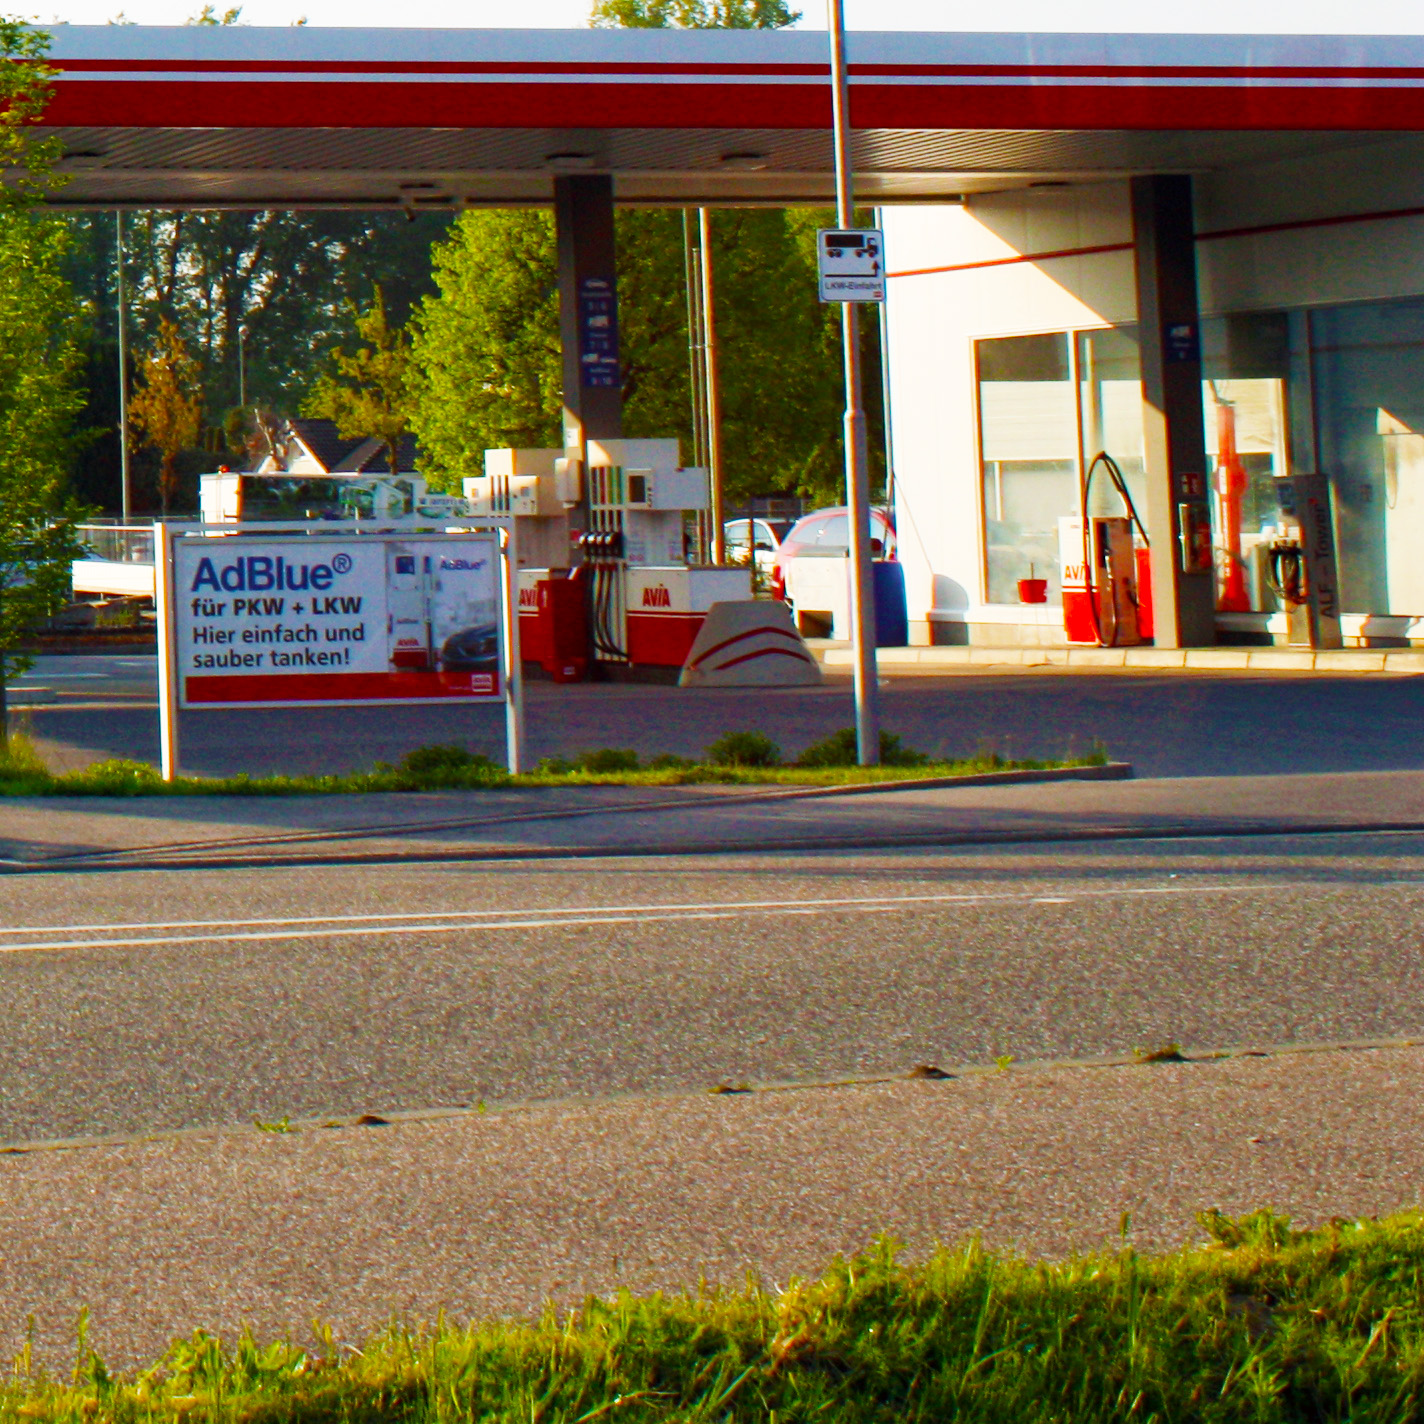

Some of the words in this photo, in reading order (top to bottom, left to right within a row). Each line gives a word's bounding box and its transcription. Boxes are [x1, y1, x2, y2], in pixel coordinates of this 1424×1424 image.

[519, 585, 538, 607] AVI
[642, 583, 671, 607] AVIA
[191, 597, 227, 617] für
[233, 597, 284, 616] PKW
[292, 602, 304, 615] +
[312, 596, 362, 615] LKW
[193, 626, 235, 644] Hier
[242, 624, 318, 643] einfach
[325, 622, 365, 642] und
[193, 649, 264, 668] sauber
[270, 647, 351, 666] tanken!
